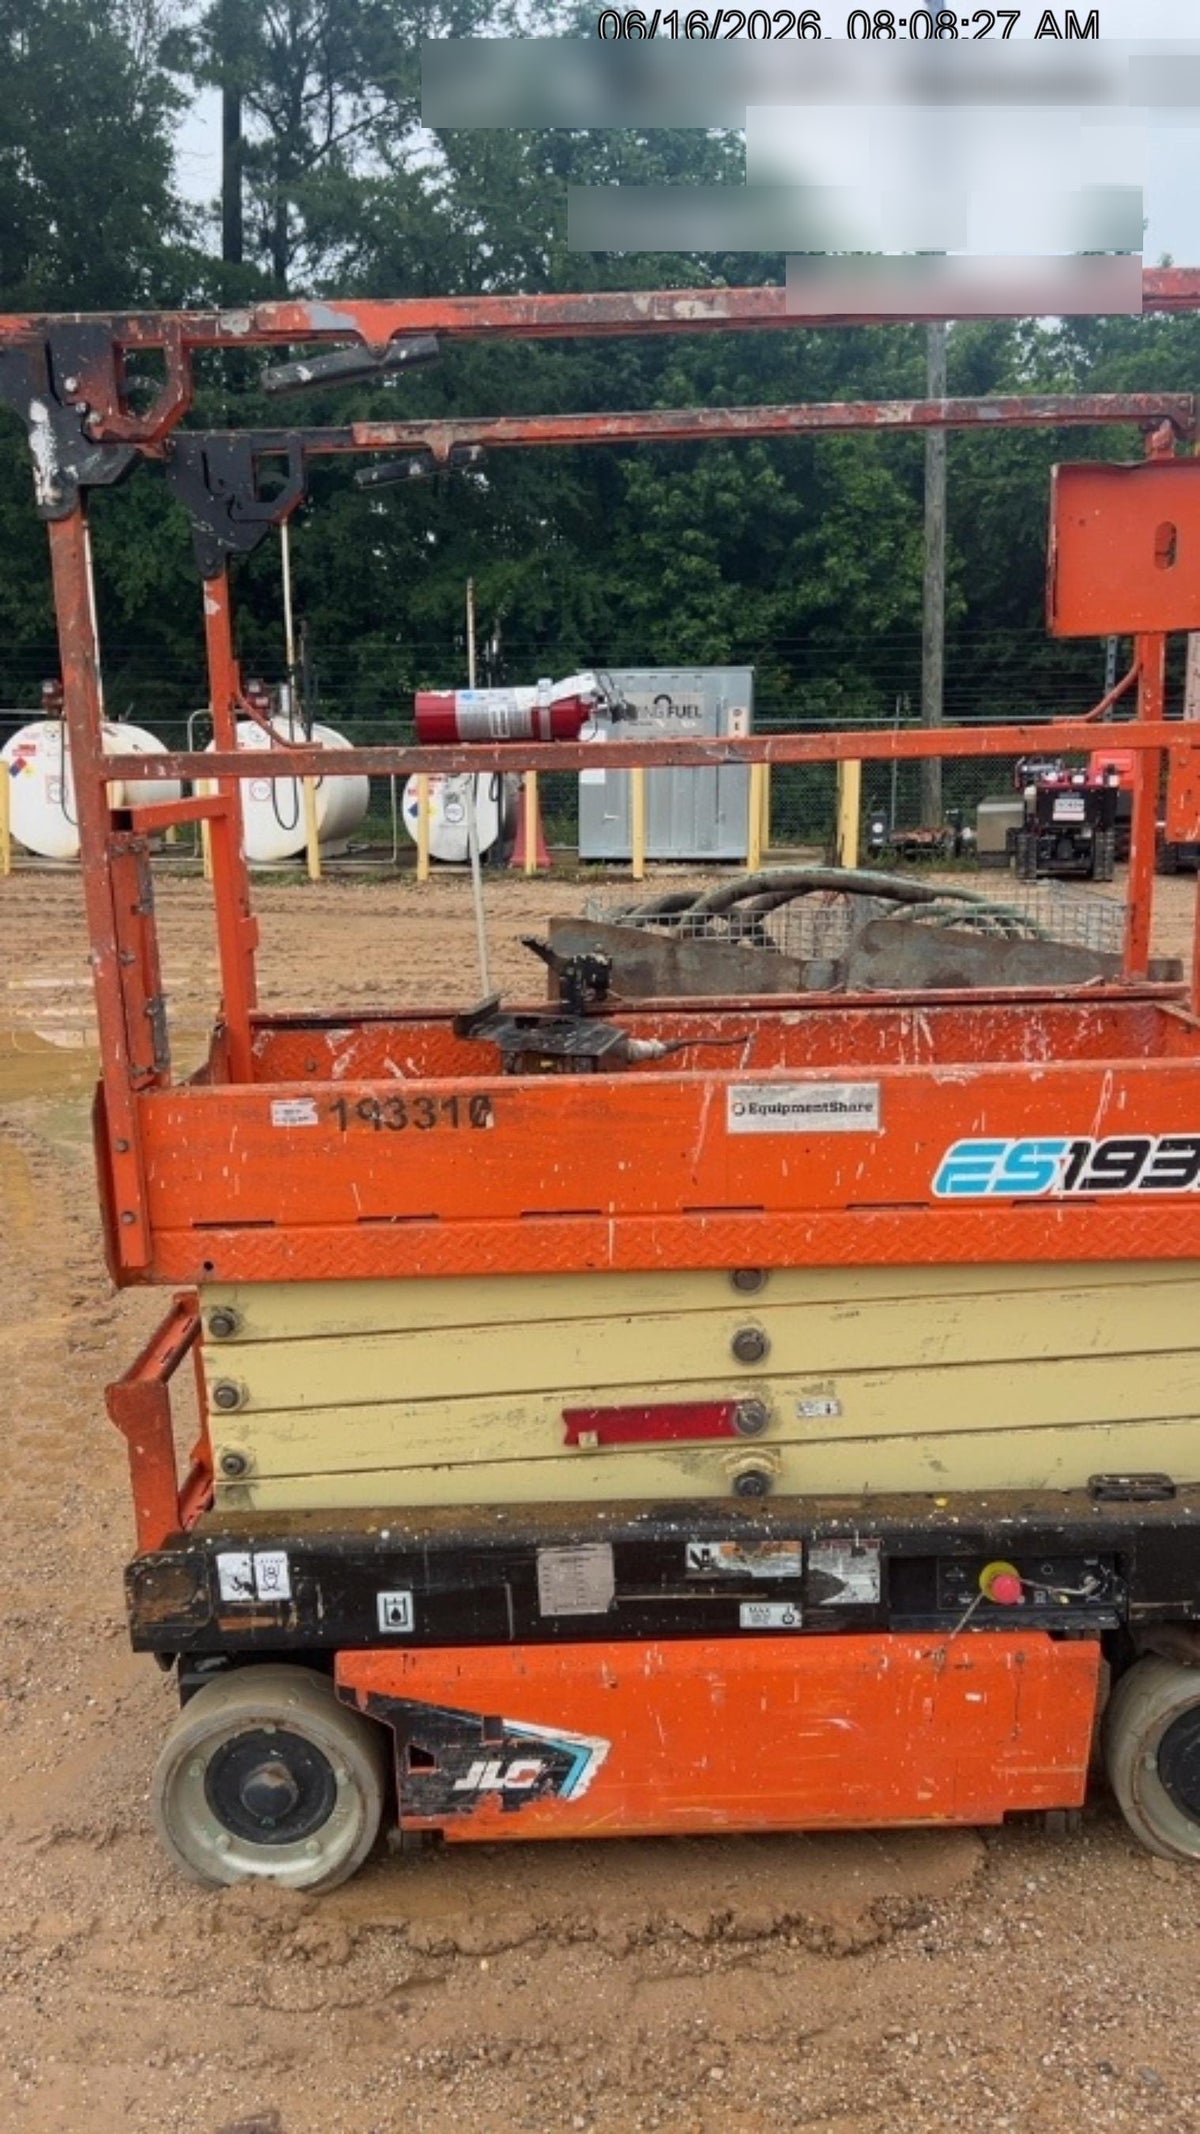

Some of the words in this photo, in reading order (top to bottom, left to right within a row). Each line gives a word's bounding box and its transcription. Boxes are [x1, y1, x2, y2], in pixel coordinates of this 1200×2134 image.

[668, 704, 702, 719] FUEL
[748, 1102, 873, 1115] EquipmentShare
[933, 1137, 1200, 1194] ES193
[453, 1760, 542, 1790] JLG
